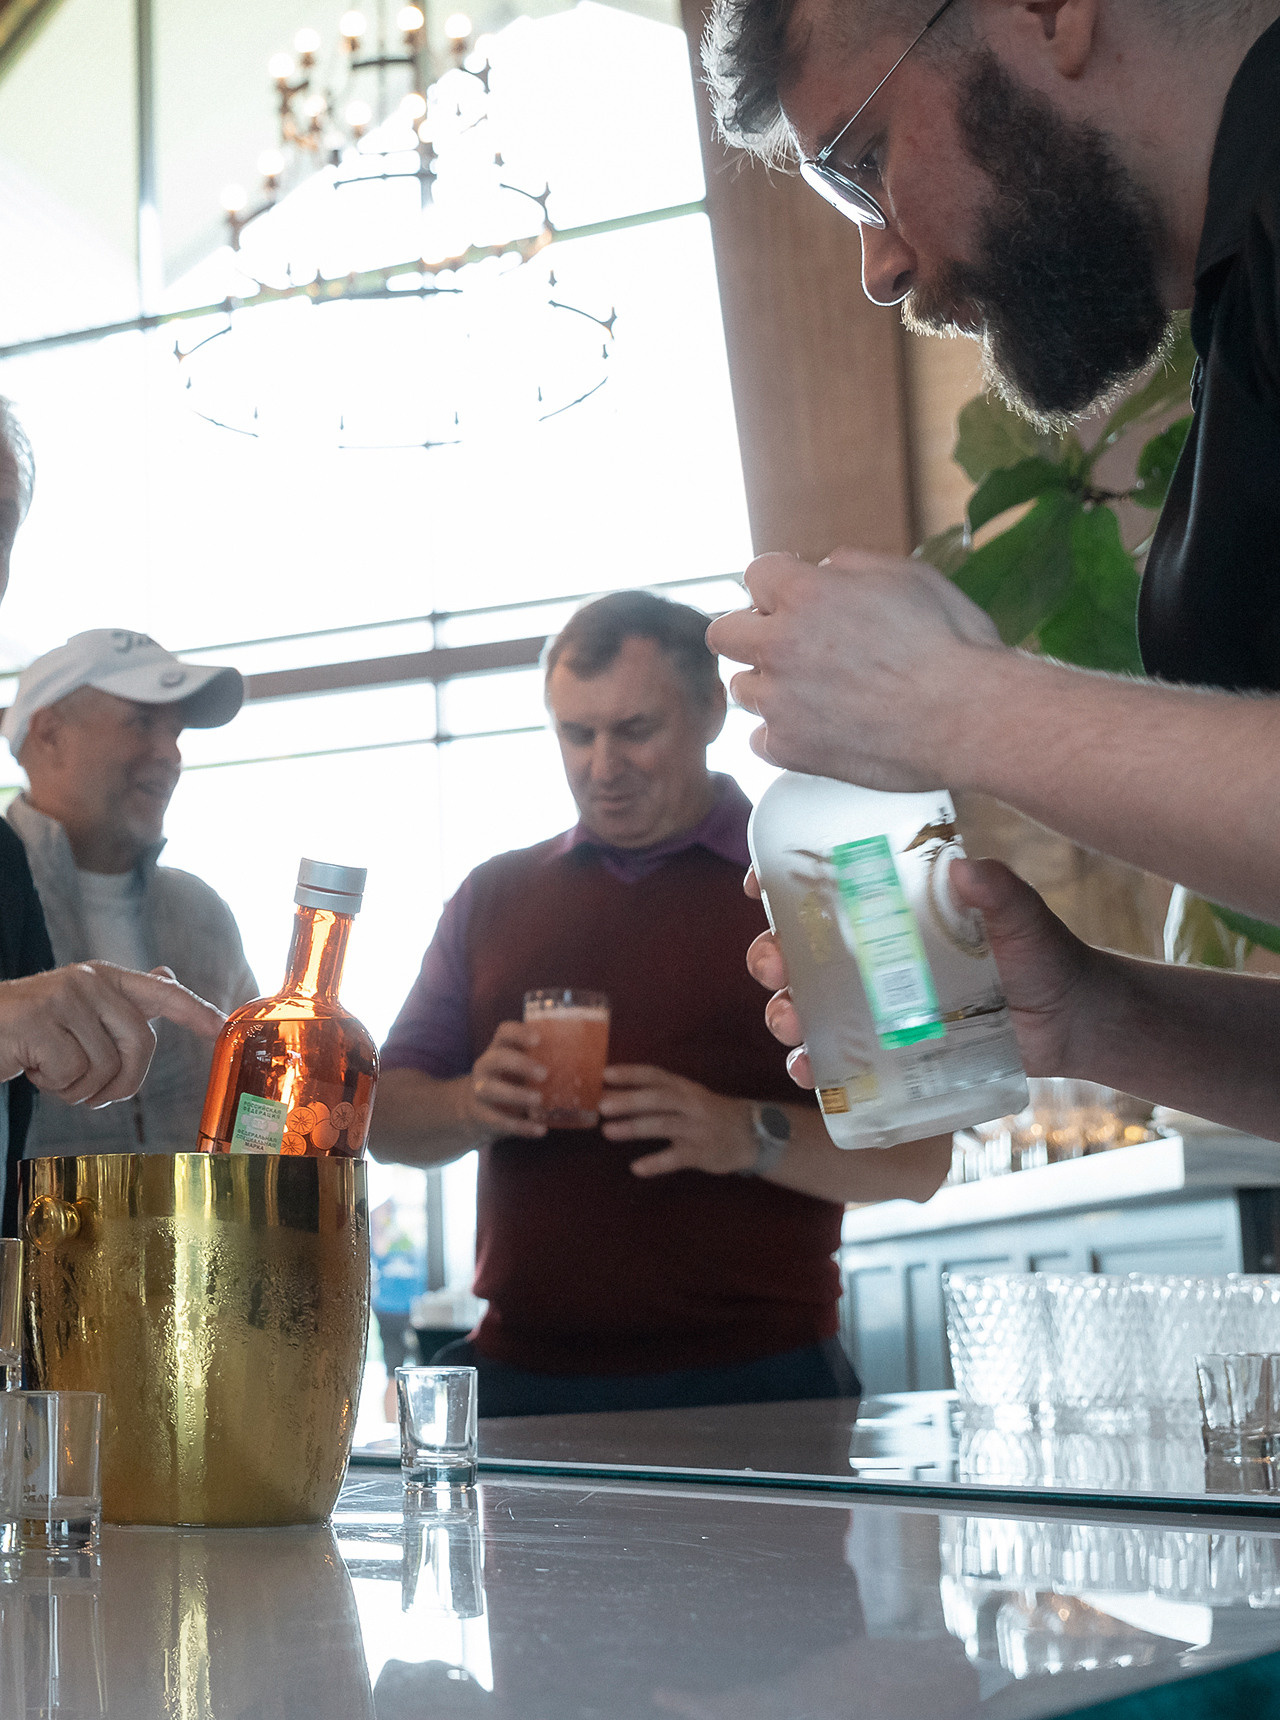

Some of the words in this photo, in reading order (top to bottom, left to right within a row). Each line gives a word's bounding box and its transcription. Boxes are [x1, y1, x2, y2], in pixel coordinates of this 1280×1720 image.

[243, 1101, 282, 1114] РОССИЙСКАЯ
[243, 1106, 281, 1120] ФЕДЕРАЦИЯ
[236, 1133, 277, 1148] СПЕЦИАЛЬНАЯ
[237, 1129, 278, 1142] ФЕДЕРАЛЬНАЯ
[244, 1142, 264, 1150] МАРКА
